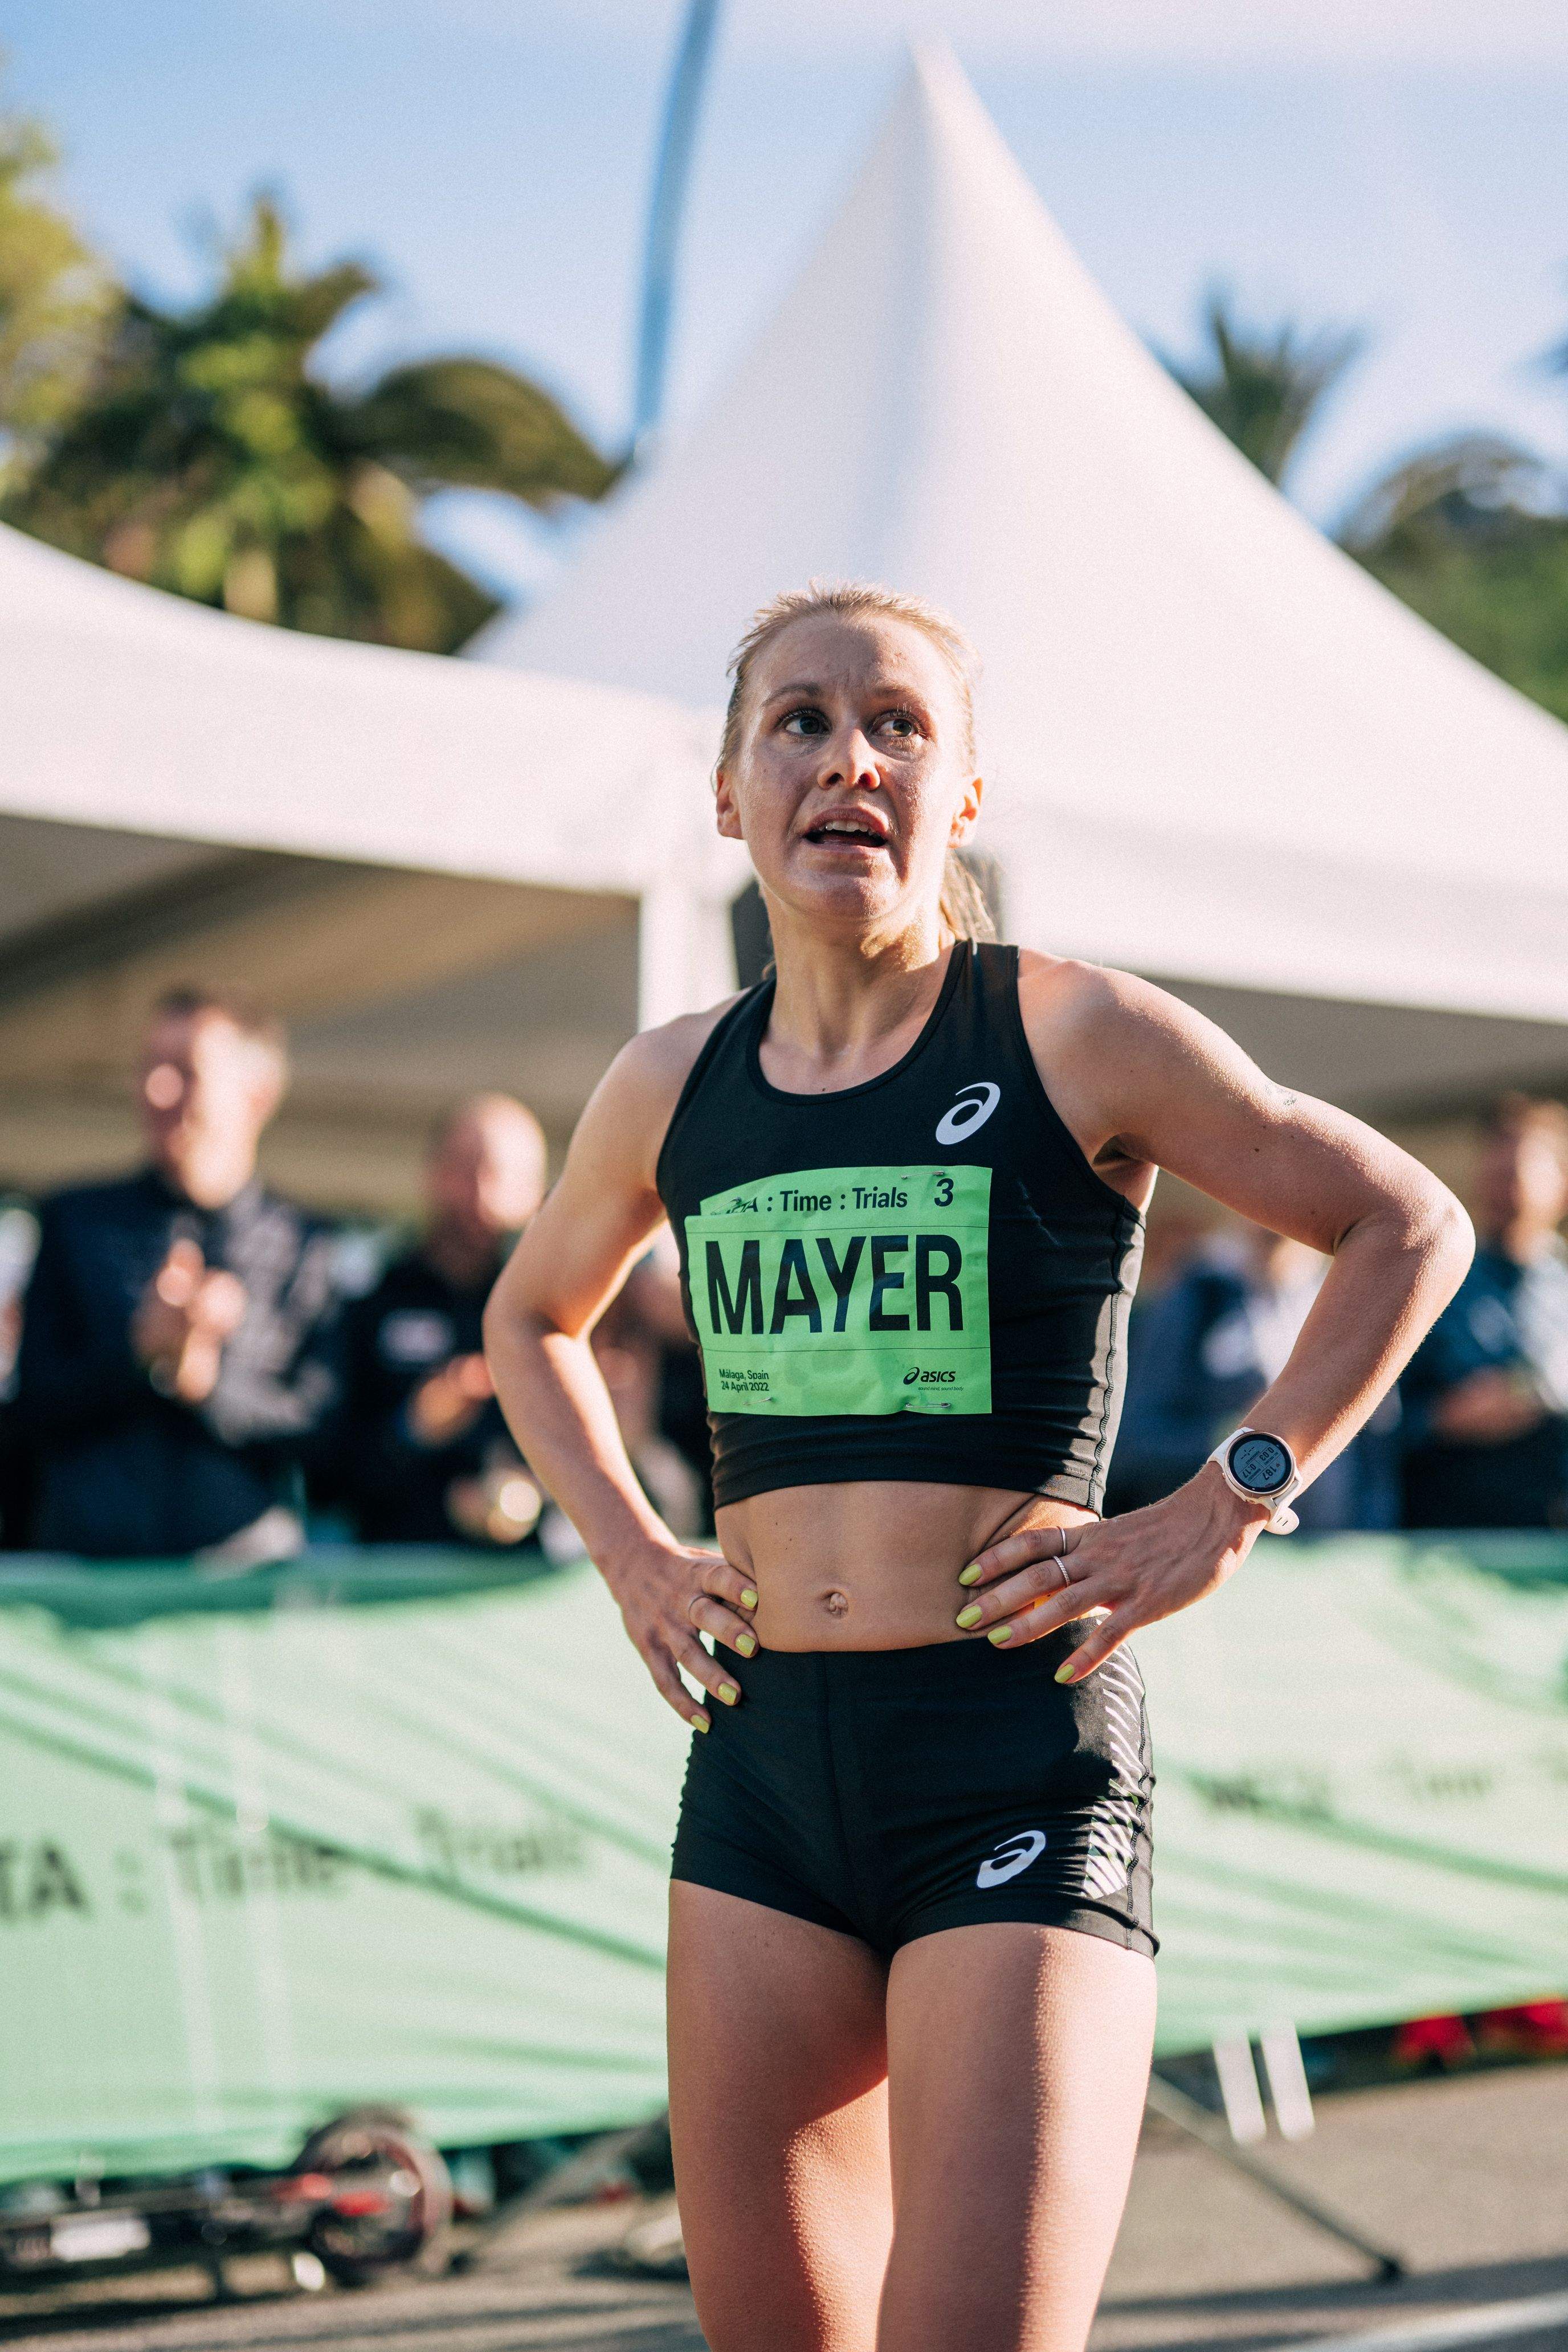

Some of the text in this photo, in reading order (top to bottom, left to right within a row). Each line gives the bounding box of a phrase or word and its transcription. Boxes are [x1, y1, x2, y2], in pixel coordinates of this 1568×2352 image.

[779, 1189, 832, 1211] Time
[852, 1186, 908, 1209] Trials
[934, 1178, 954, 1207] 3
[705, 1234, 963, 1335] MAYER
[719, 1369, 769, 1381] Málaga, Spain
[721, 1381, 770, 1393] 24 April 2022
[1259, 1447, 1275, 1461] 0.03
[1242, 1463, 1257, 1479] 0:17
[1262, 1465, 1277, 1481] 187
